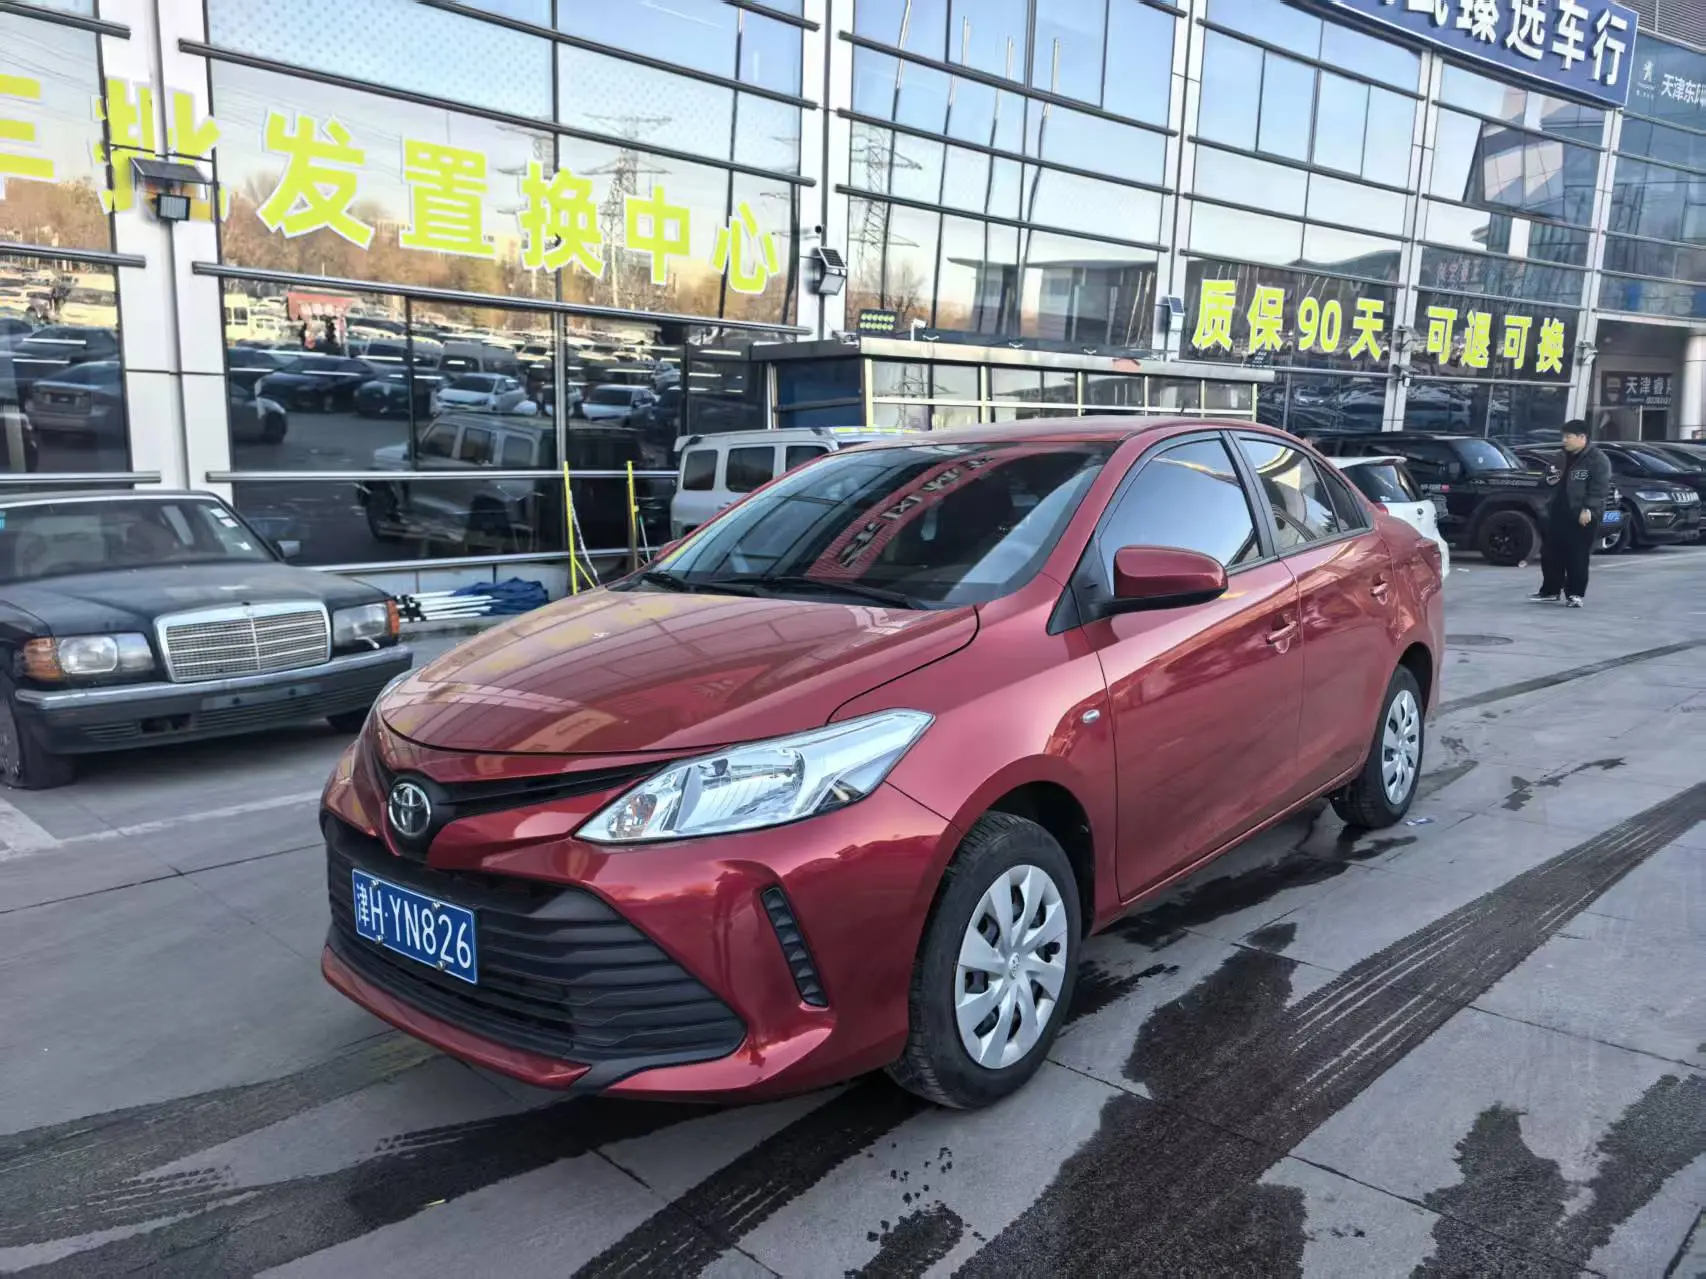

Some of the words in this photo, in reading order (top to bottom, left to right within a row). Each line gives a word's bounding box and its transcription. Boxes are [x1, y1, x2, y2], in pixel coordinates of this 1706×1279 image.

[1192, 278, 1386, 362] 质保90天
[1426, 305, 1566, 375] 可退可换
